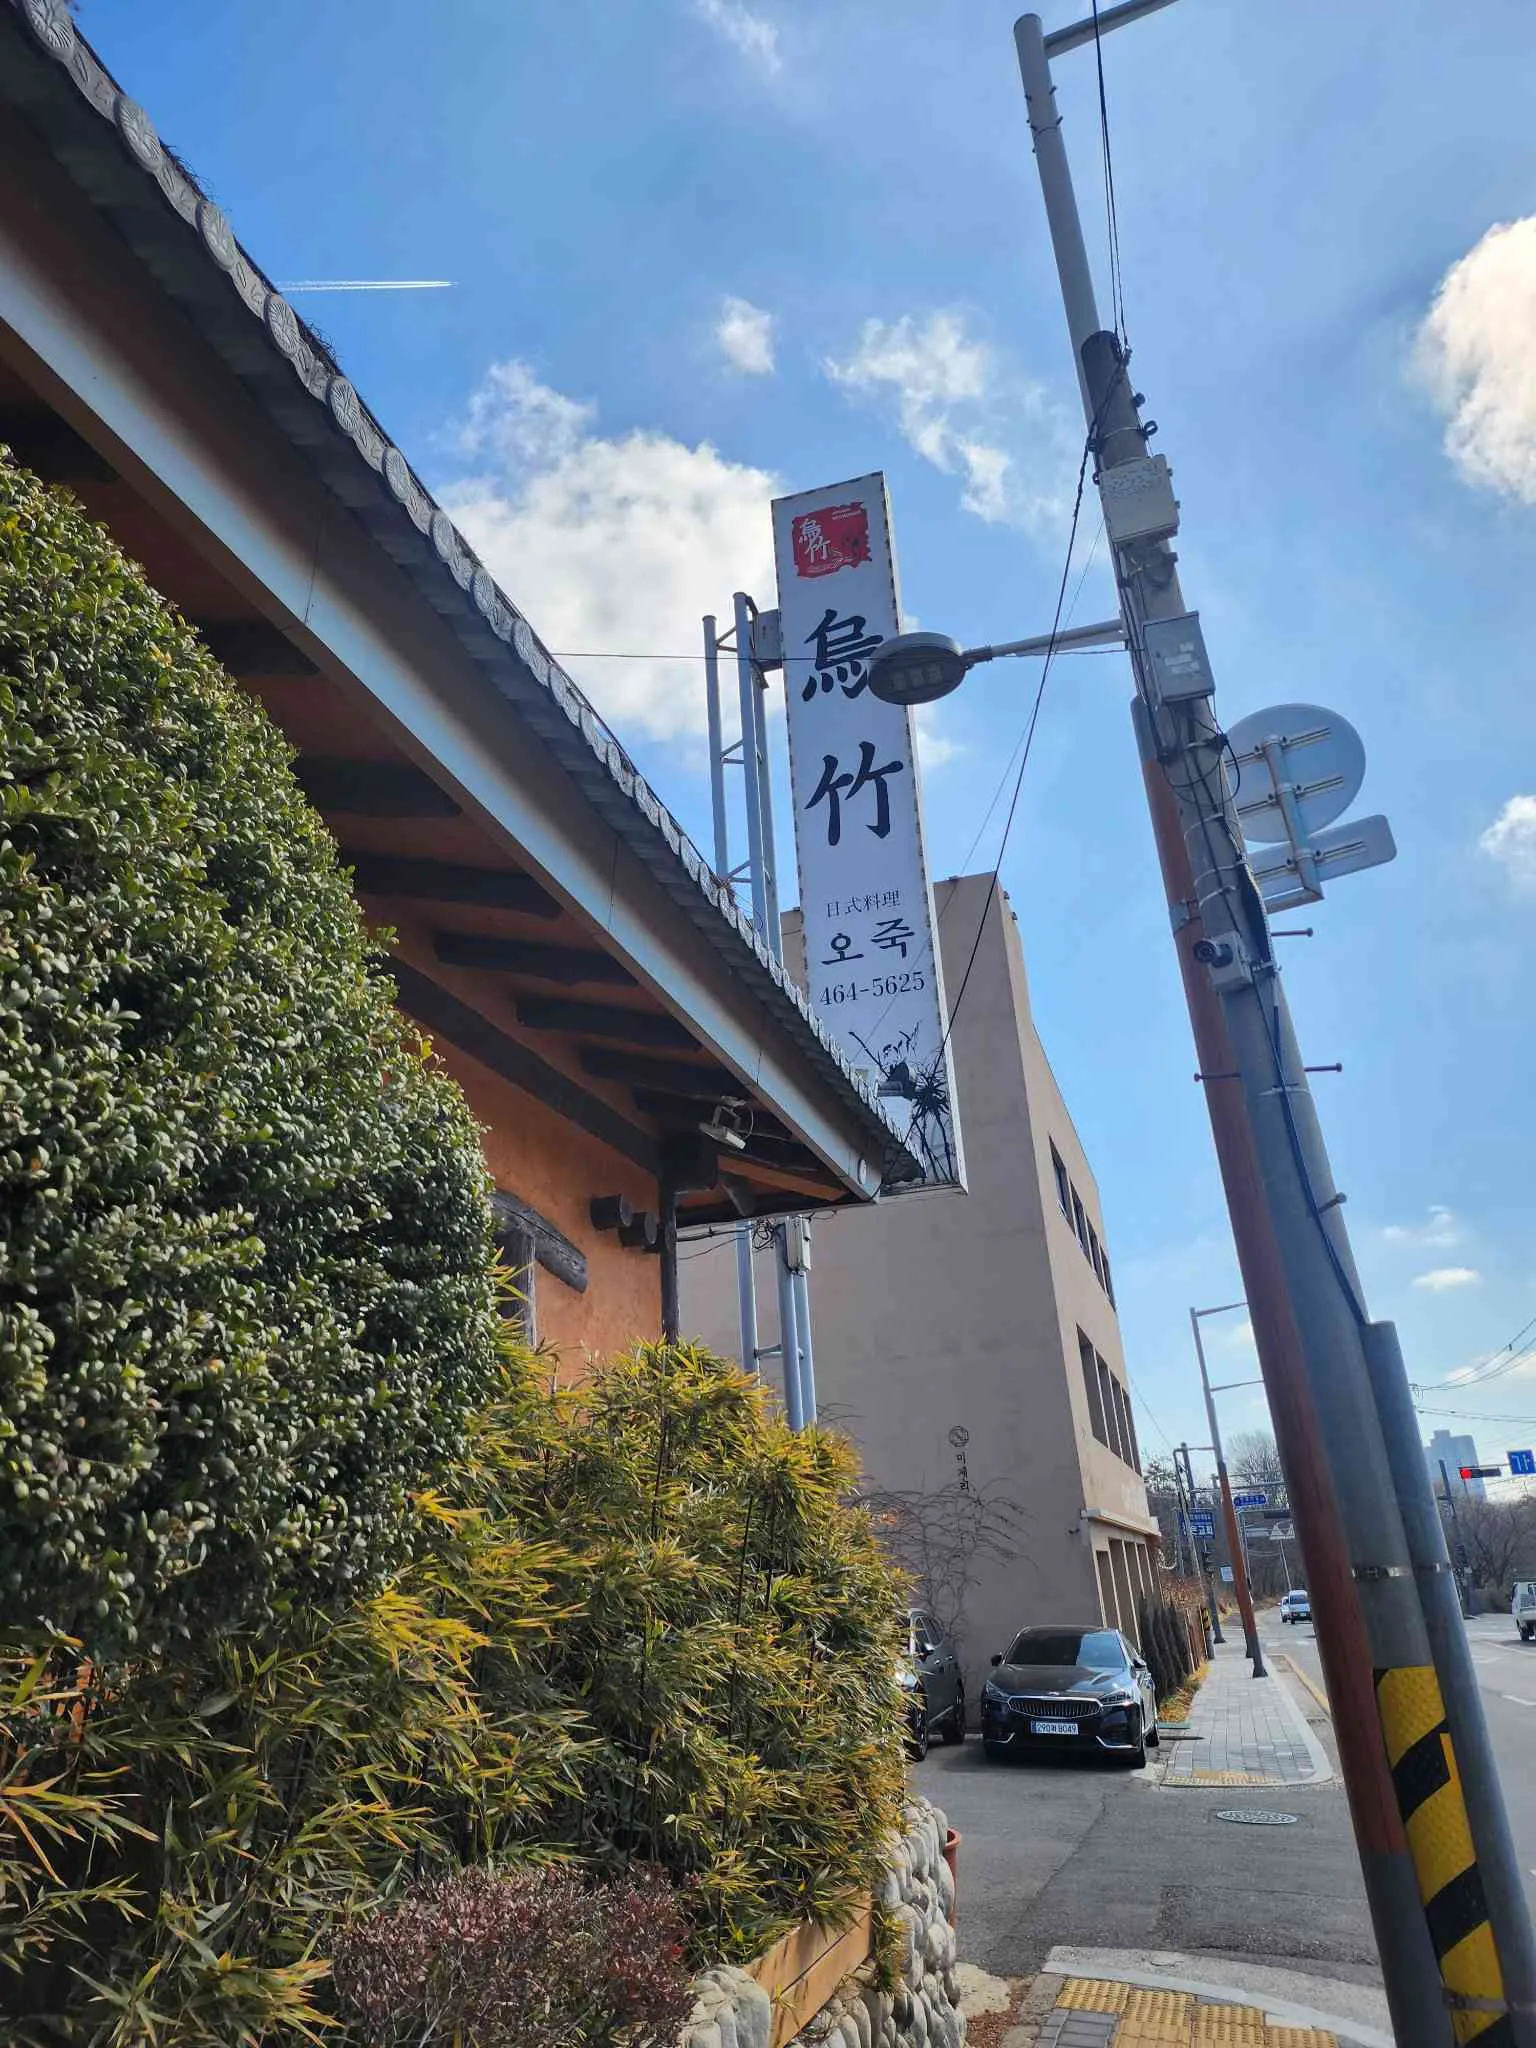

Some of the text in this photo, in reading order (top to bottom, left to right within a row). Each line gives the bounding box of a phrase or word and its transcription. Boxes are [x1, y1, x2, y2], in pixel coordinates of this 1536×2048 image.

[826, 888, 901, 919] 日式料理
[821, 918, 915, 966] 오죽
[819, 971, 925, 1006] 464-5625
